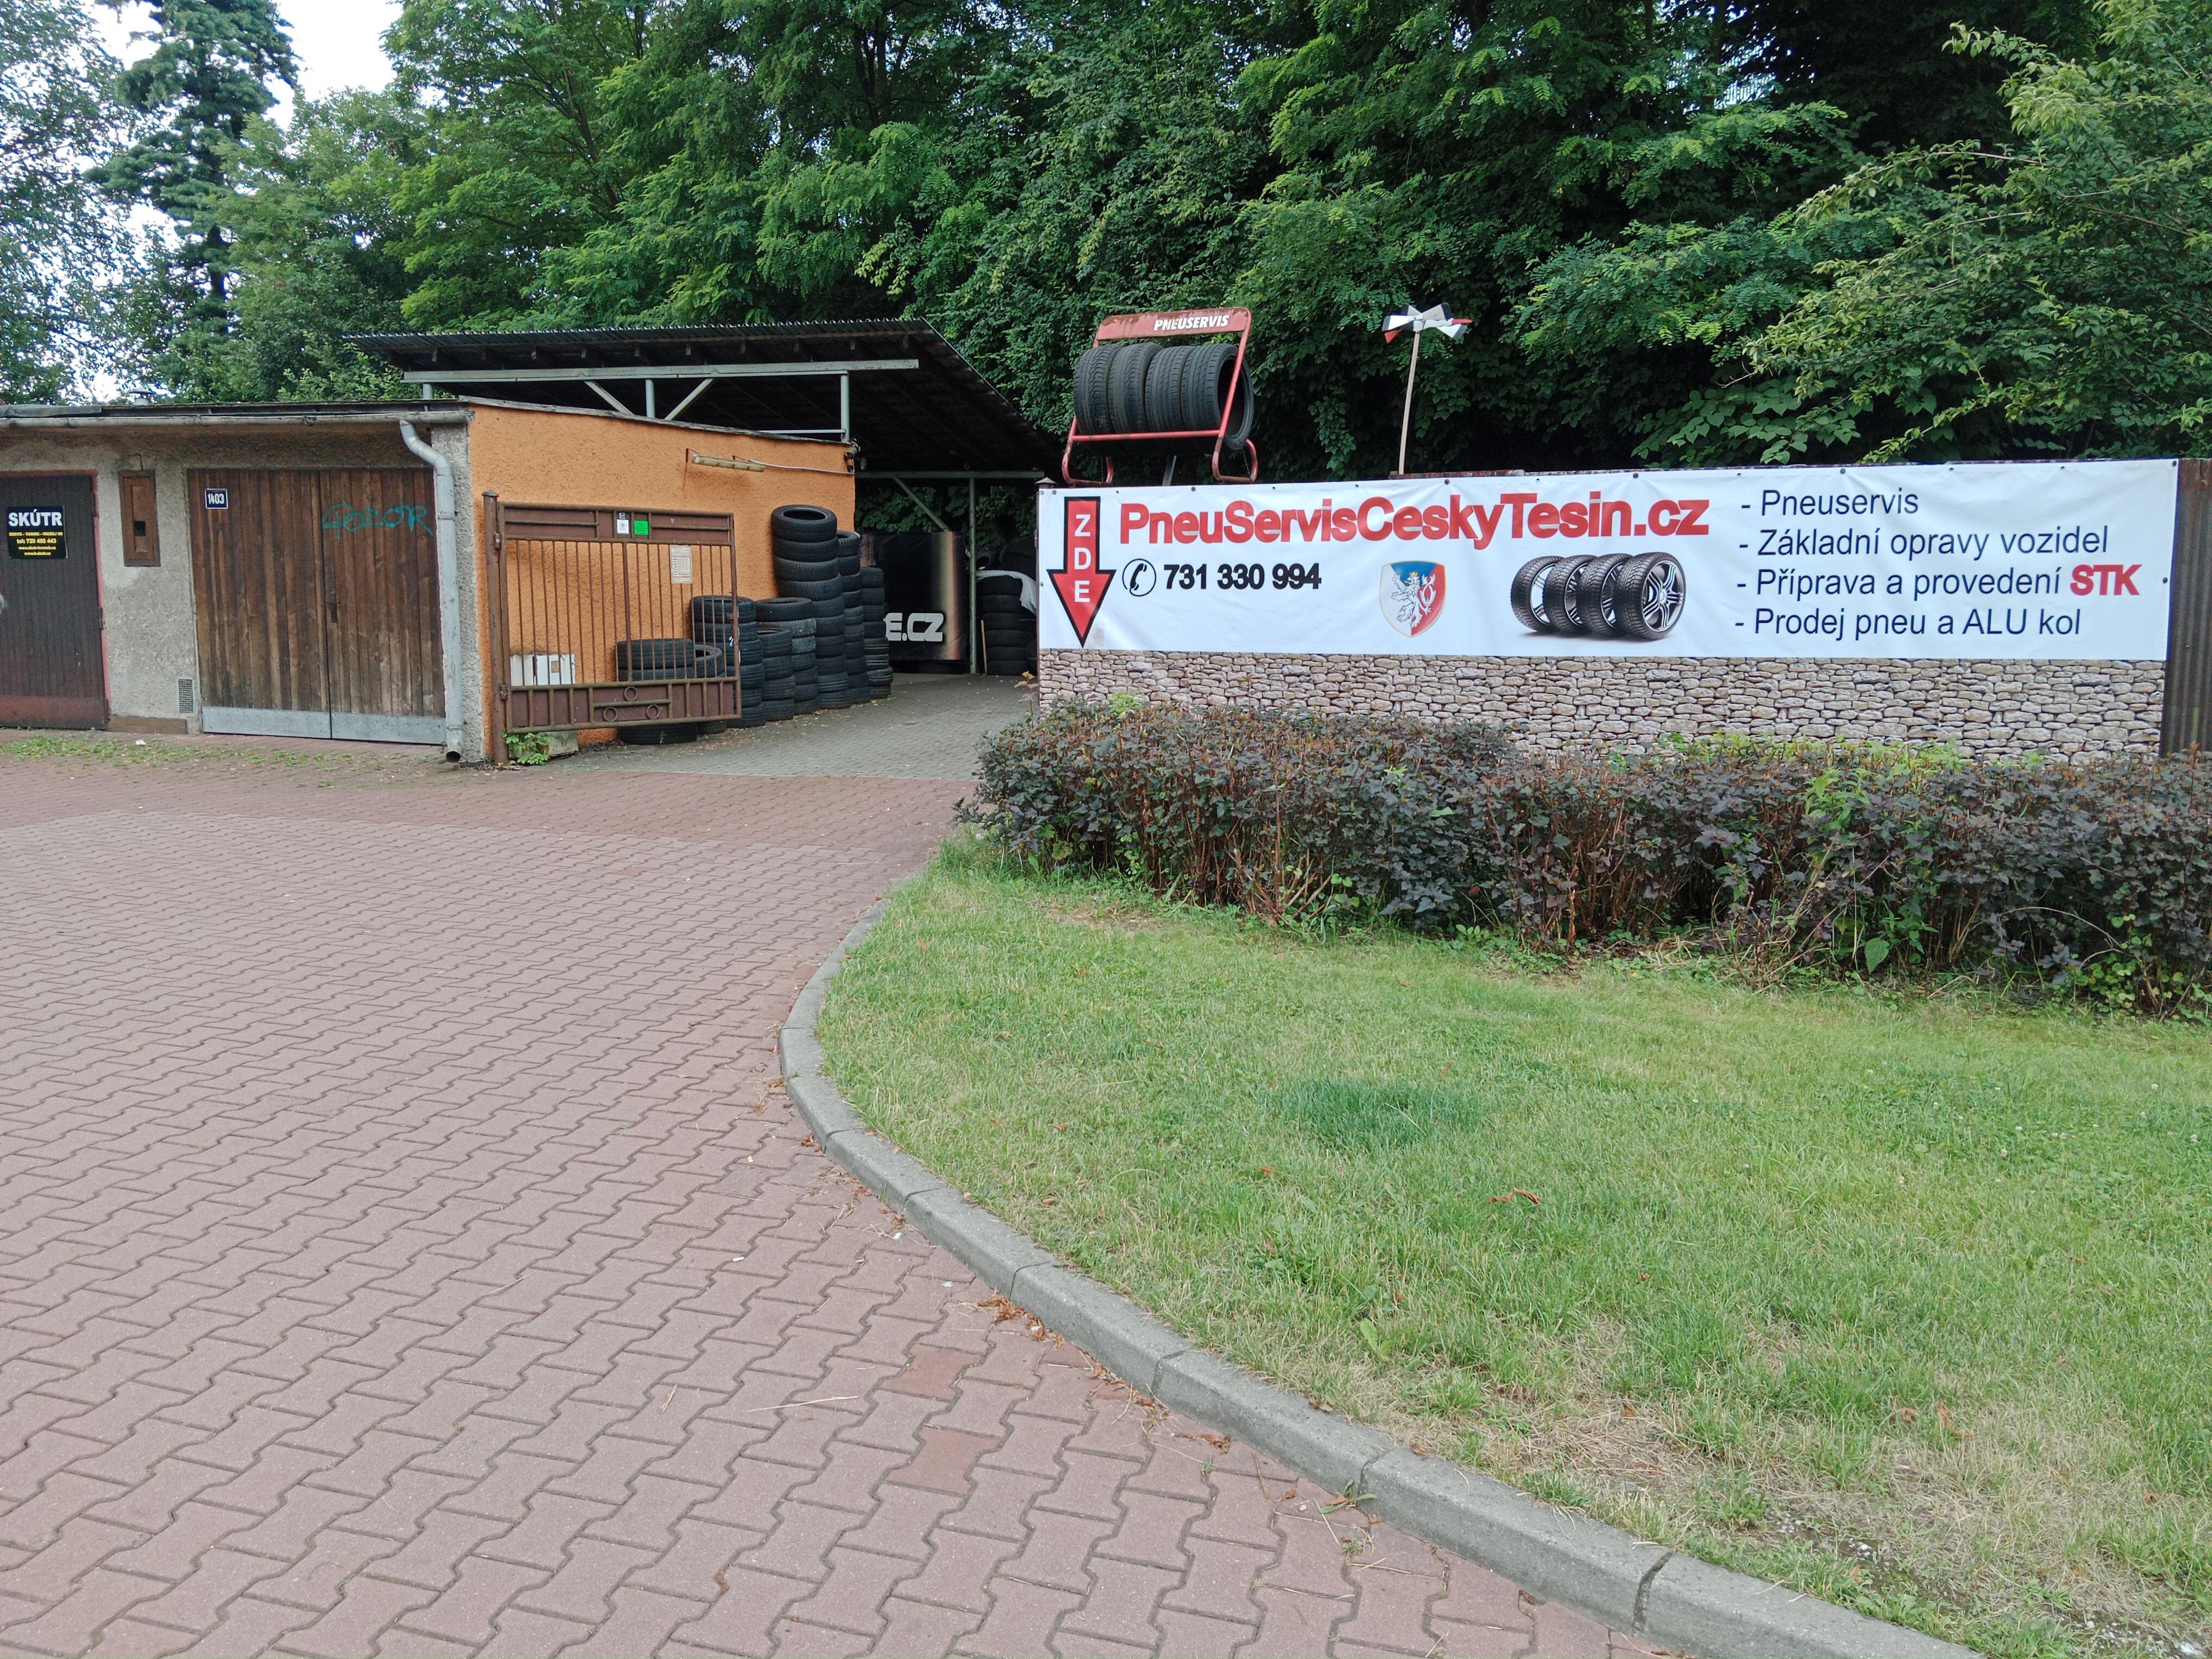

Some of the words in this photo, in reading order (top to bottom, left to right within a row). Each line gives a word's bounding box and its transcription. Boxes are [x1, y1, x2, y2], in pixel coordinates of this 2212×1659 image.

[1154, 315, 1229, 331] PNEUSERVIS
[207, 493, 225, 504] 1403
[1761, 487, 1919, 516] Pneuservis
[8, 509, 62, 526] SKÚTR
[1120, 491, 1710, 550] PneuServisCeskyTesin.cz
[1757, 527, 1880, 555] Základní
[1890, 533, 1989, 561] opravy
[2000, 525, 2108, 554] vozidel
[1074, 514, 1092, 602] ZDE
[1164, 564, 1207, 589] 731
[1217, 564, 1265, 589] 330
[1272, 563, 1322, 590] 994
[1757, 568, 1875, 600] Příprava
[1886, 575, 1902, 594] a
[1913, 567, 2062, 601] provedení
[2070, 564, 2142, 596] STK
[883, 612, 944, 641] E.CZ
[1755, 608, 1845, 641] Prodej
[1855, 614, 1926, 640] pneu
[1937, 615, 1954, 634] a
[1961, 608, 2027, 634] ALU
[2039, 608, 2081, 634] kol
